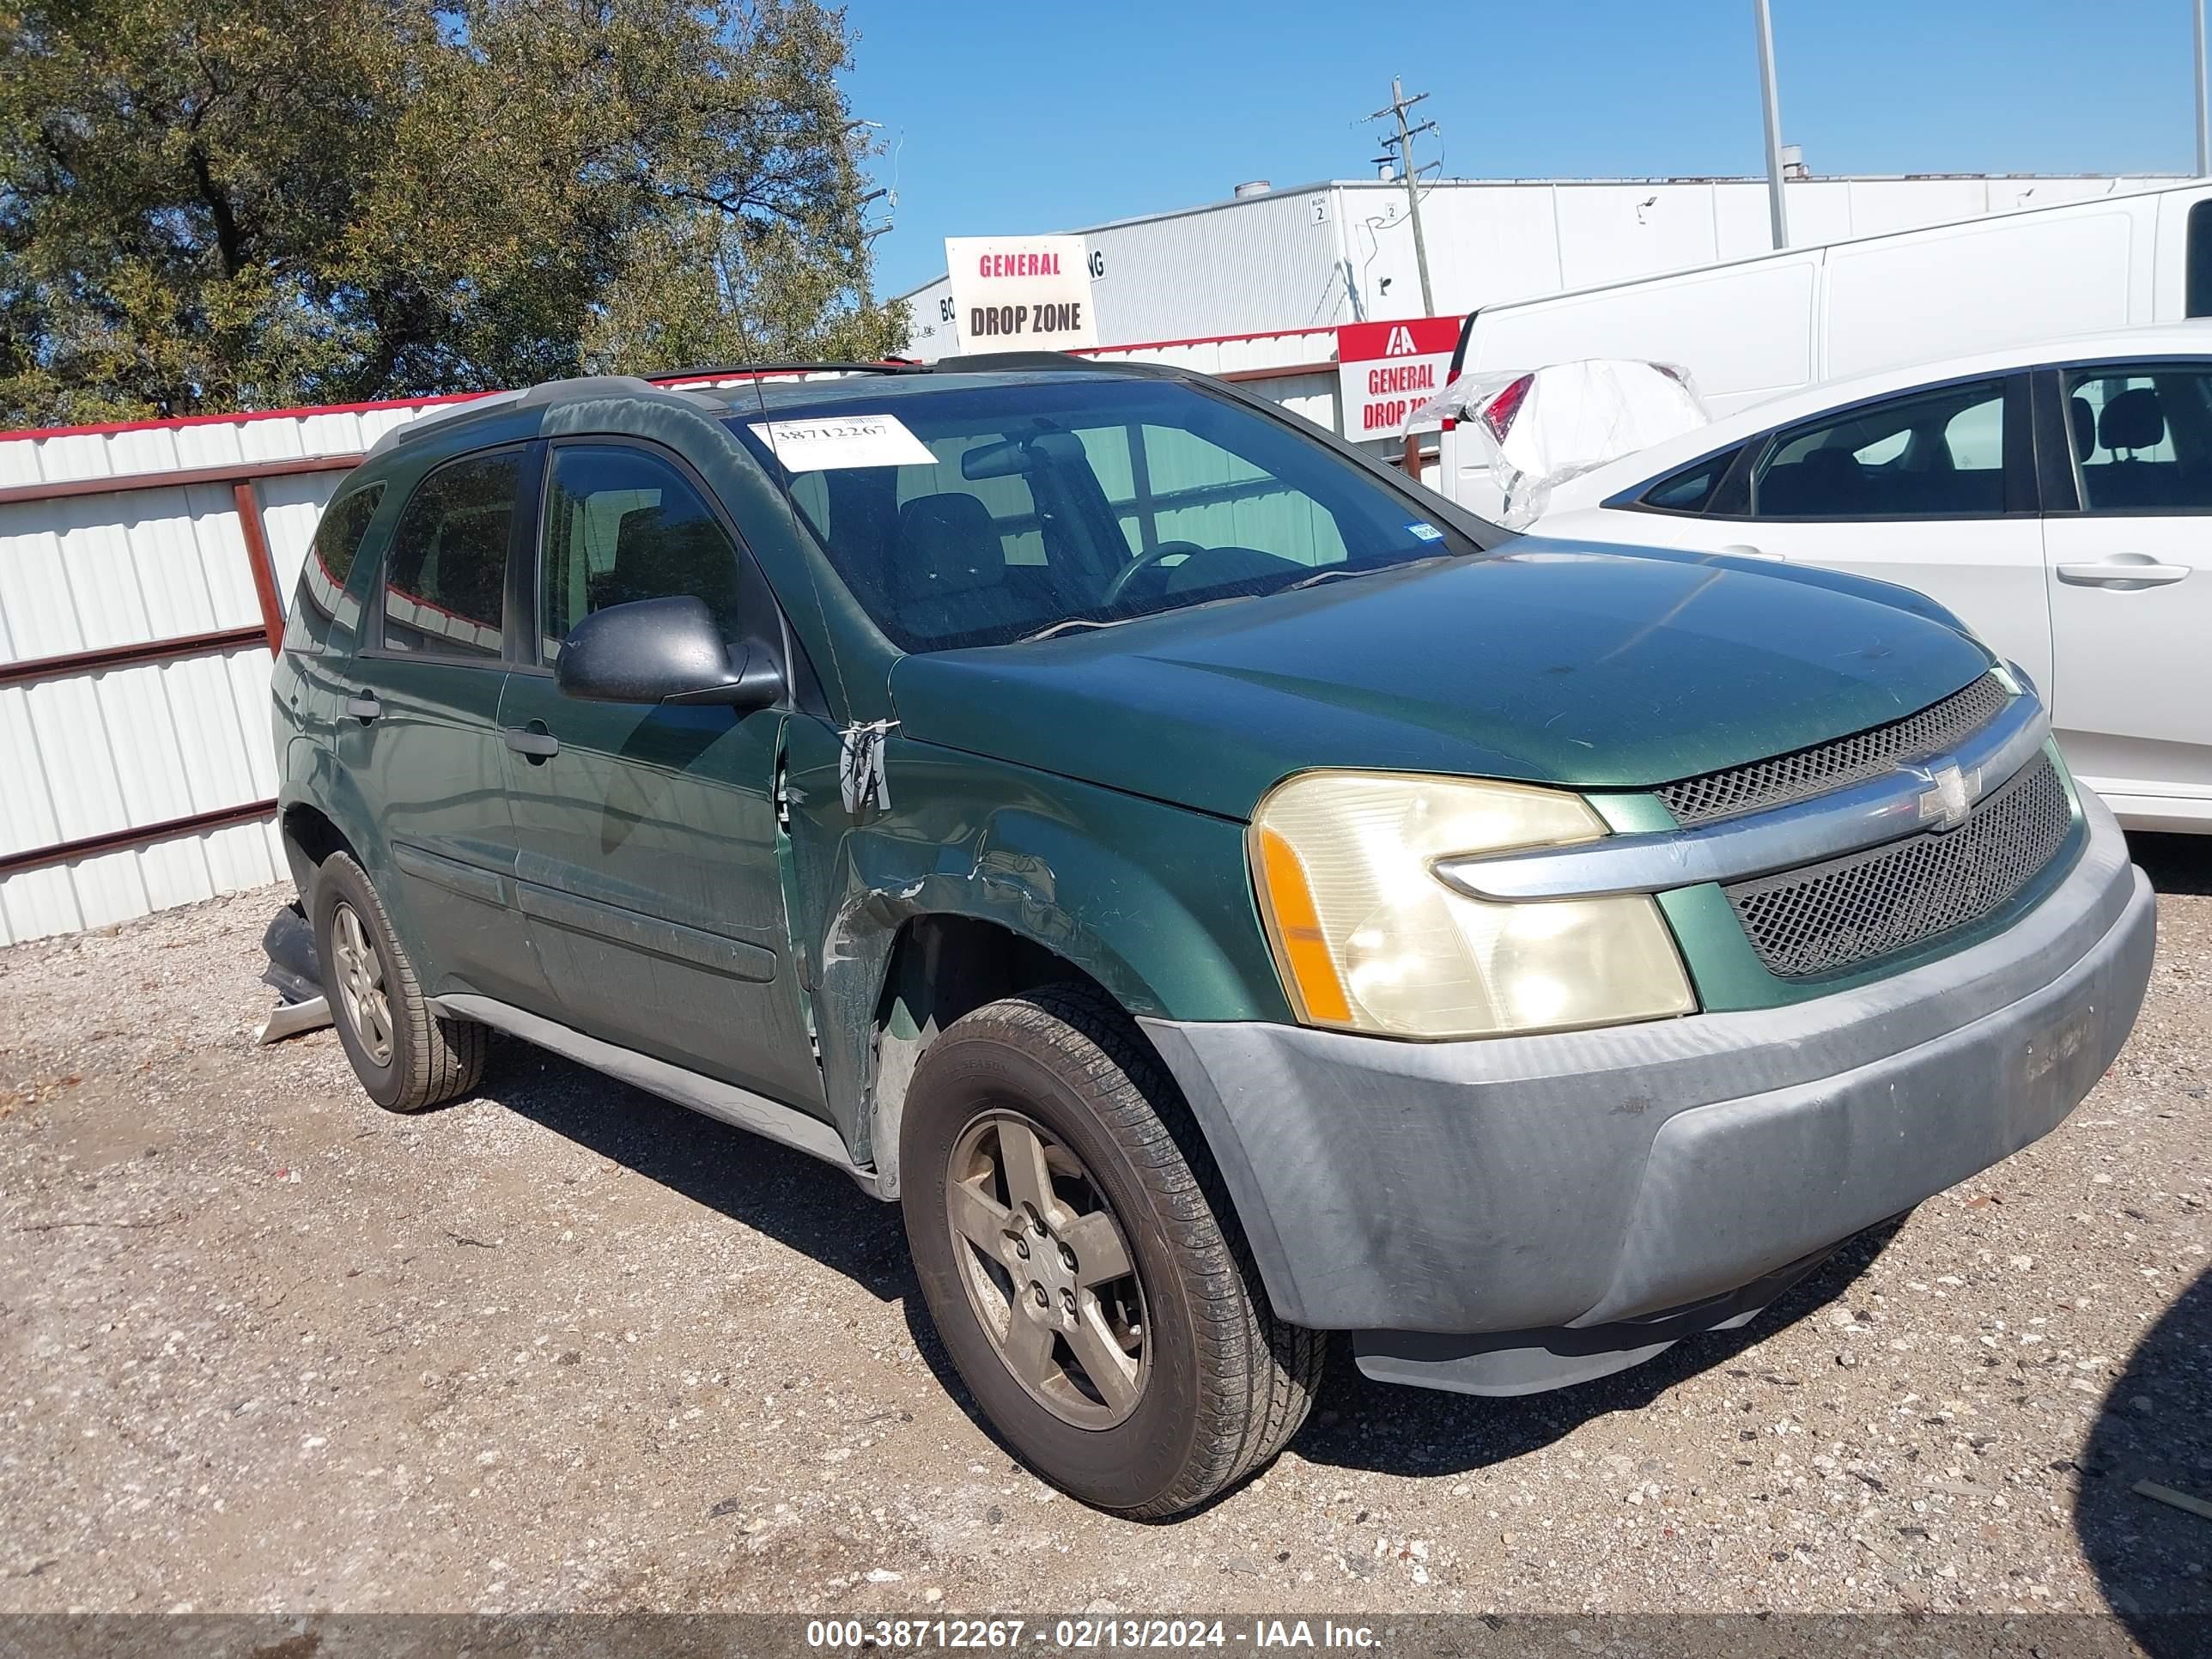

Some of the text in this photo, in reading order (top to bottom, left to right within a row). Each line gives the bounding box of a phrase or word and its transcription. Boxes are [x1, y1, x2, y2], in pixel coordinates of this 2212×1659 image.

[1316, 208, 1323, 220] 2
[1389, 207, 1395, 217] 2
[979, 253, 1061, 278] GENERAL
[971, 302, 1081, 337] DROP ZONE
[1369, 364, 1436, 396] GENERAL
[1364, 399, 1406, 430] DROP
[775, 425, 887, 441] 38712267
